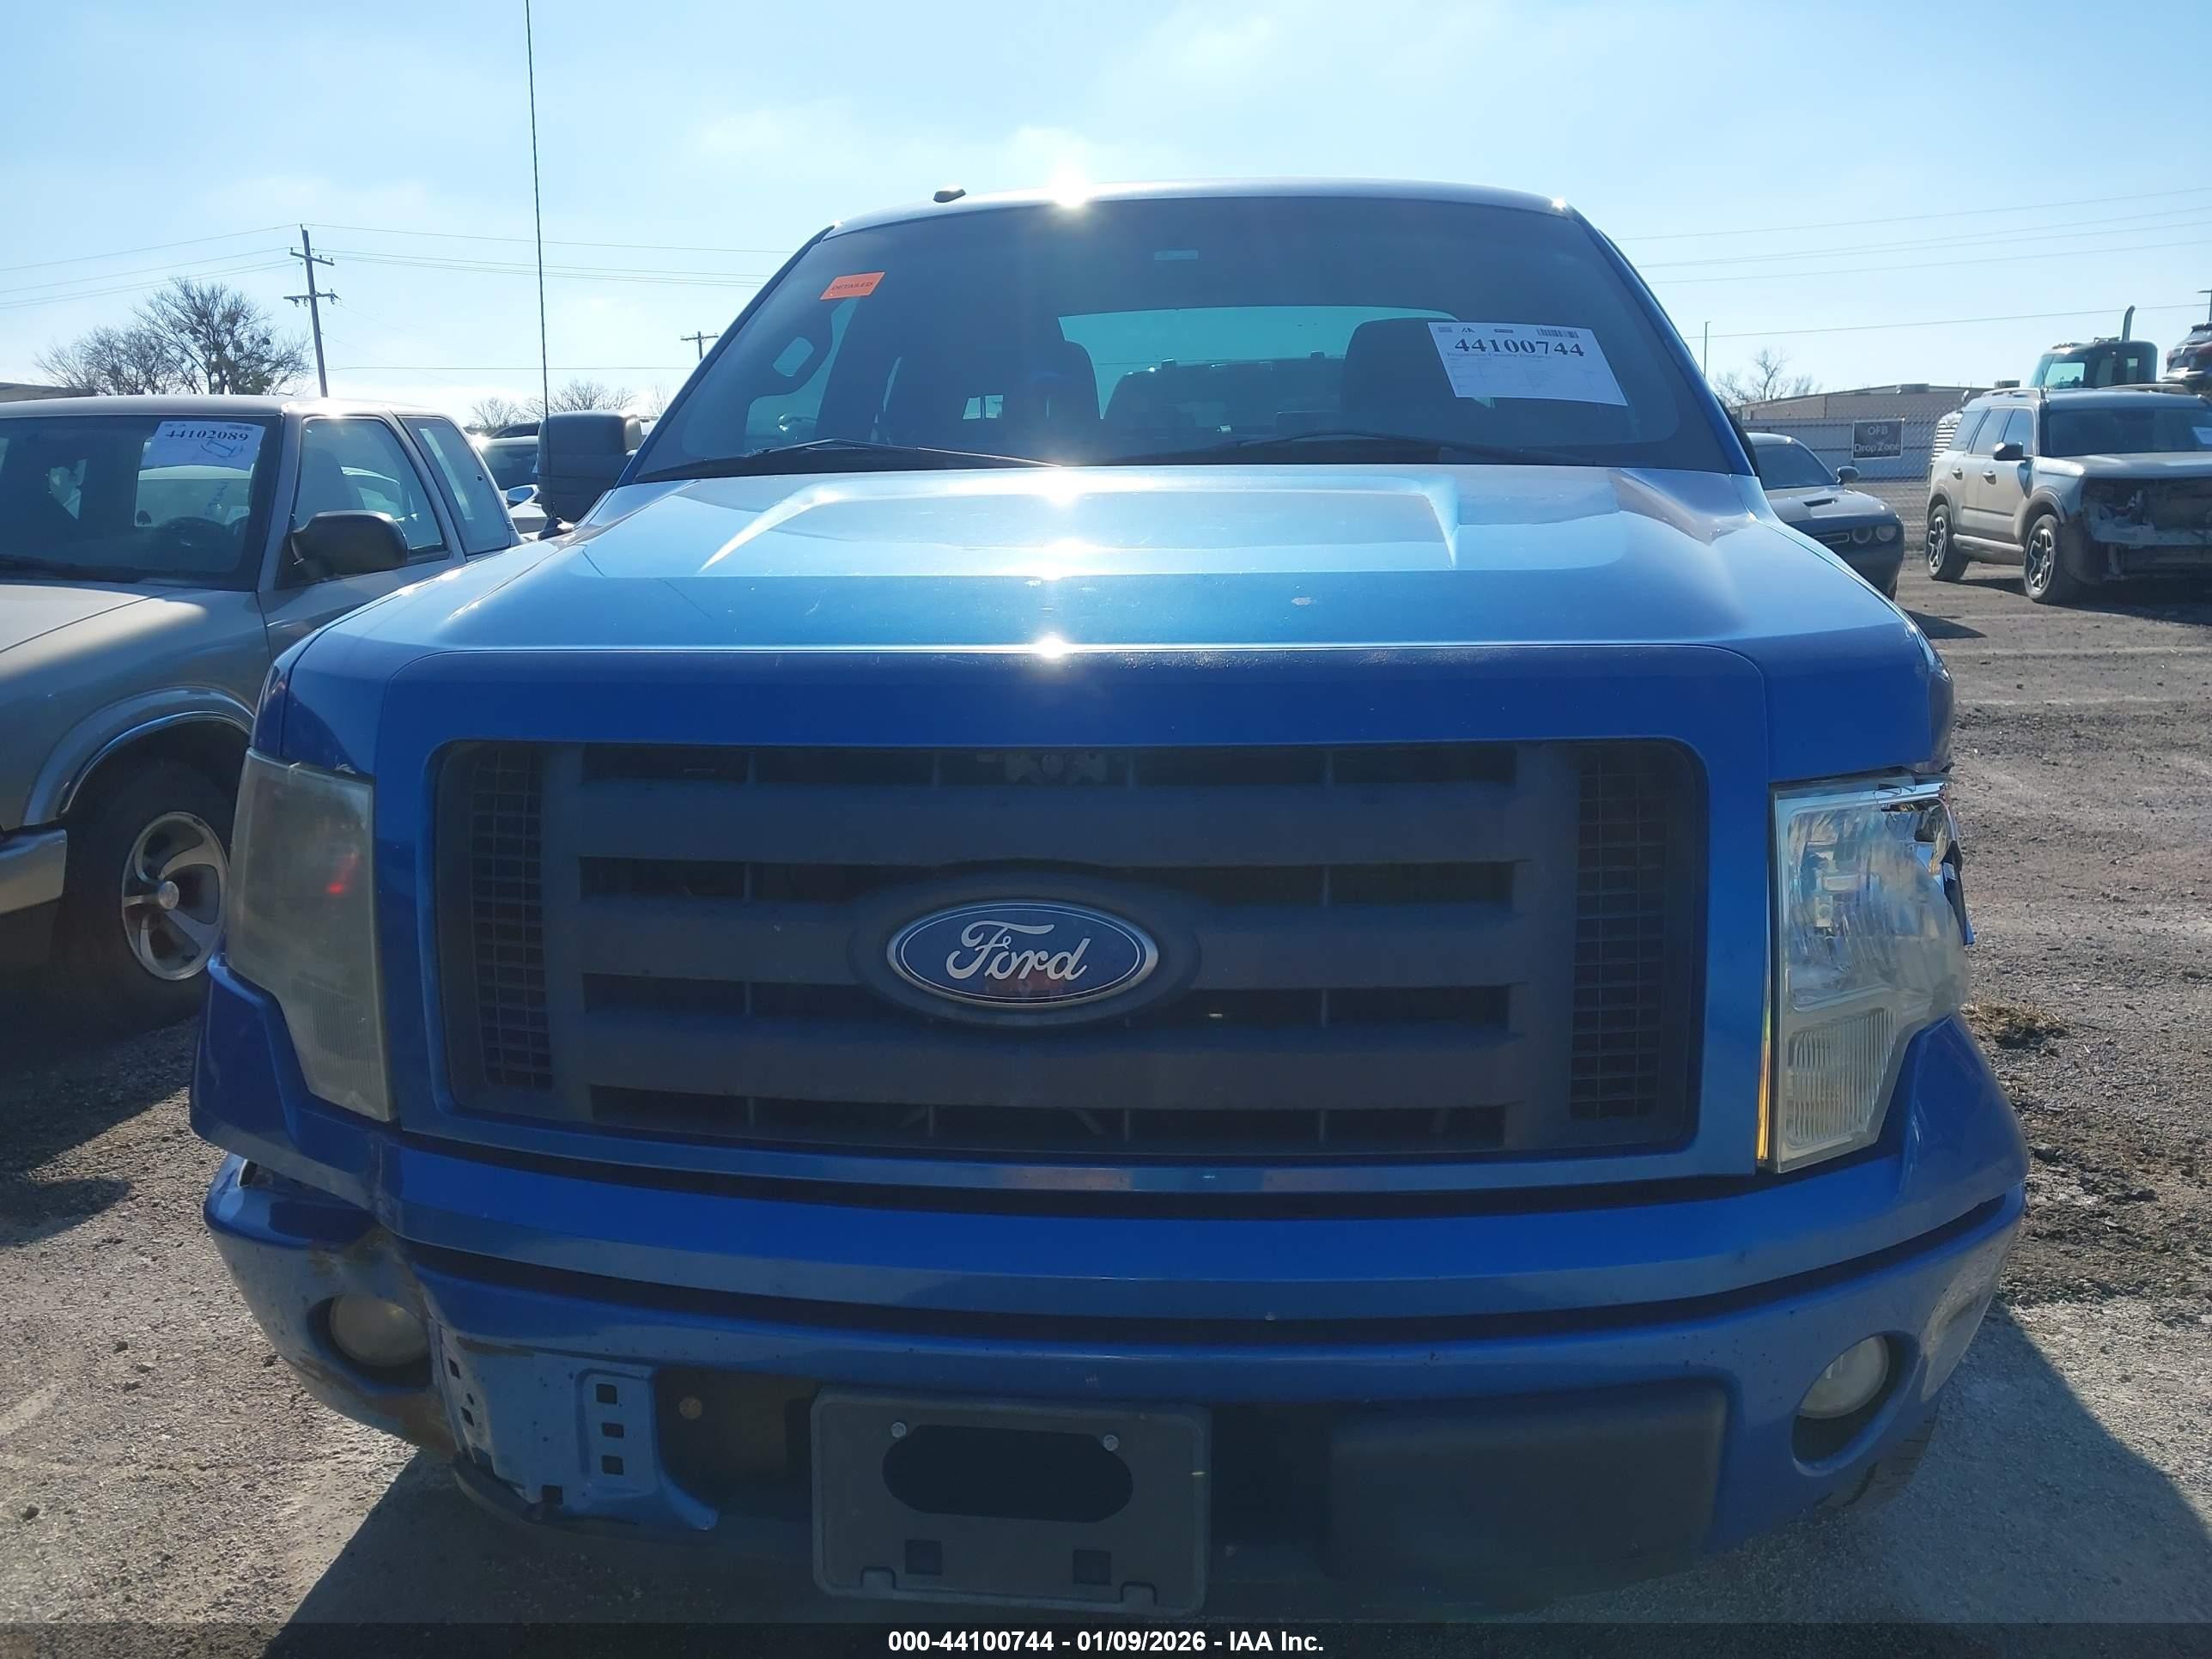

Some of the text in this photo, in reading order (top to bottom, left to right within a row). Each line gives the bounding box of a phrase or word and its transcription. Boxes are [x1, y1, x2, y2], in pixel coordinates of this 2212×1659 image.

[1455, 338, 1585, 357] 44100744
[164, 429, 249, 441] 44102089
[1854, 441, 1900, 453] Drop Zone
[946, 921, 1091, 981] Ford
